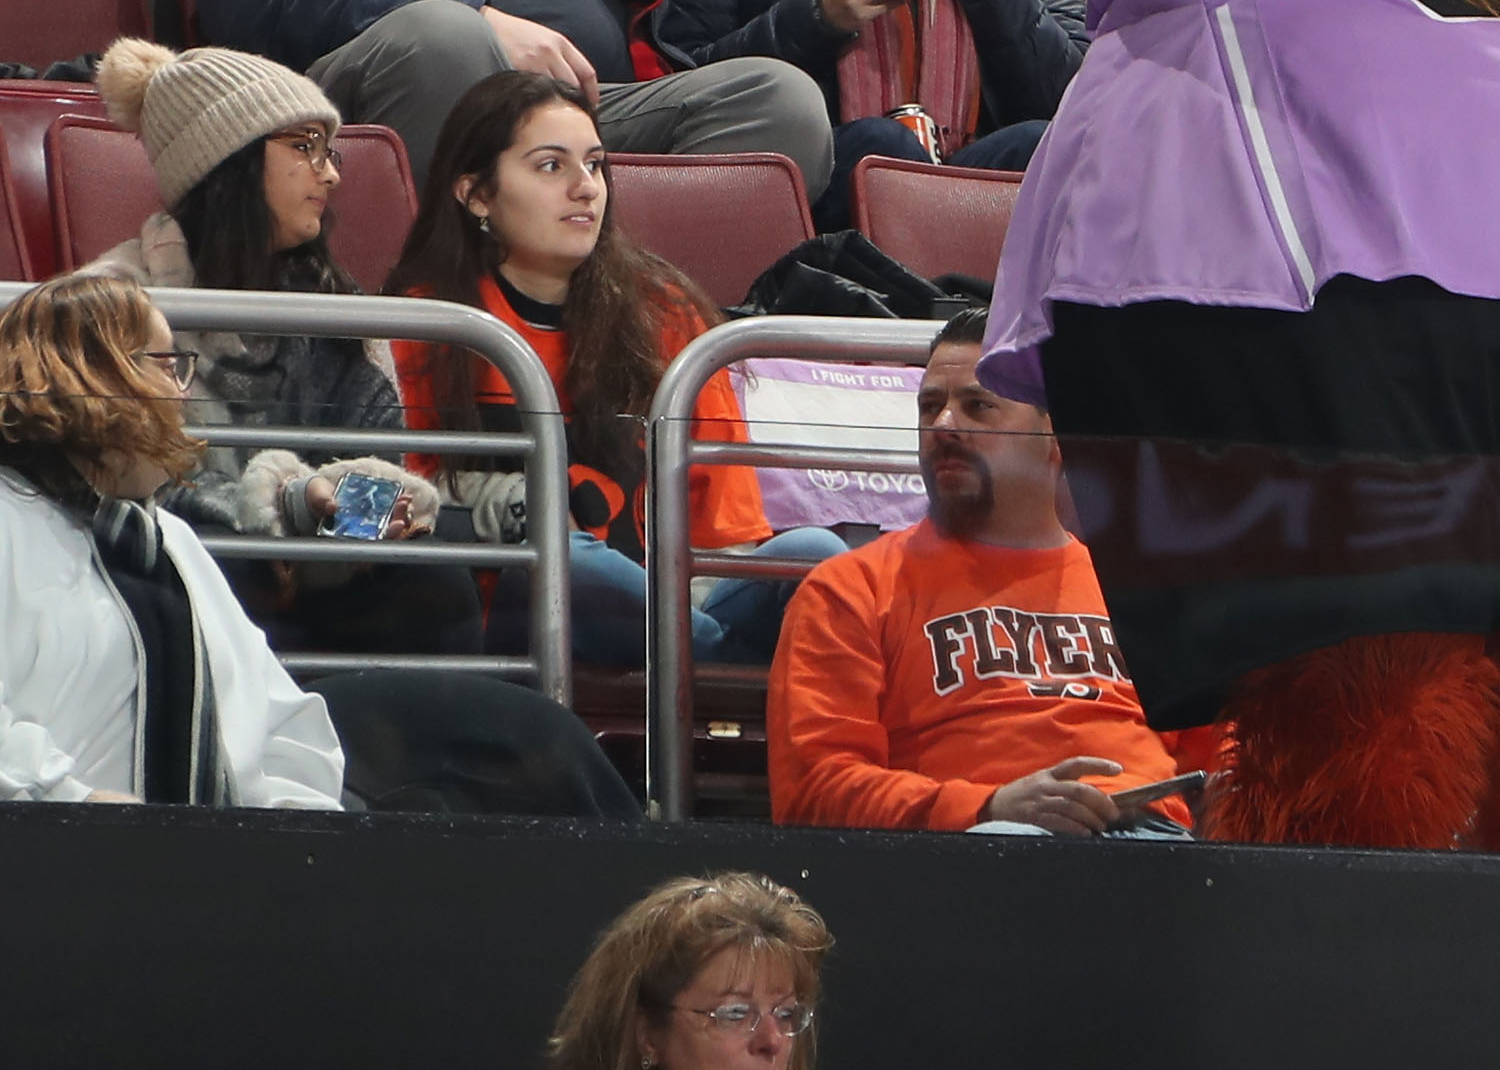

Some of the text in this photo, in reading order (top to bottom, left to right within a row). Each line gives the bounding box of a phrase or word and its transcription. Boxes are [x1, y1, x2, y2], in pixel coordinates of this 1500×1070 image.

[811, 370, 904, 388] I FIGHT FOR
[850, 471, 927, 495] TOYO
[923, 606, 1133, 697] FLYER
